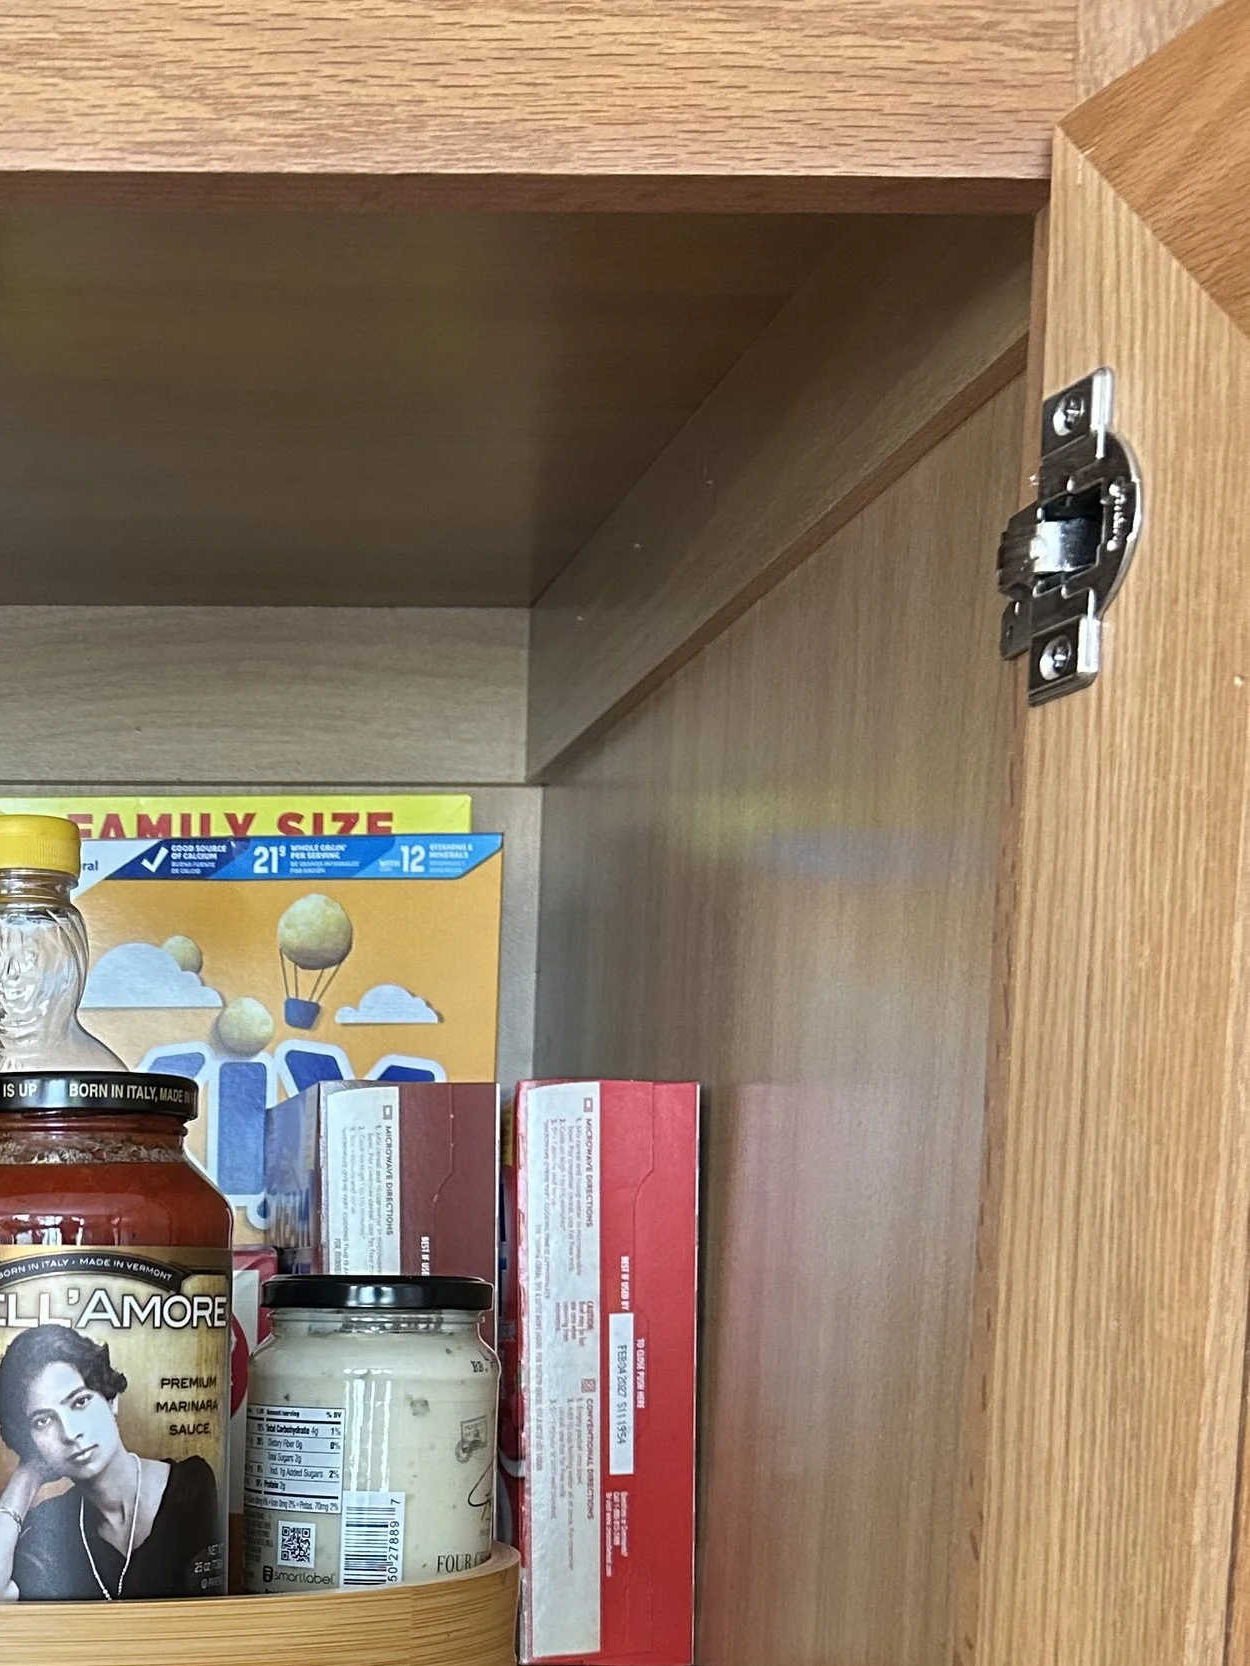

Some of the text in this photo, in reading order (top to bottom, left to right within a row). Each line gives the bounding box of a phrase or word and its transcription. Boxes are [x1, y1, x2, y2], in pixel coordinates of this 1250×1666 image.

[66, 811, 394, 839] FAMILY SIZE
[400, 845, 425, 873] 12
[2, 1082, 15, 1098] IS
[18, 1082, 38, 1097] UP
[69, 1082, 183, 1103] BORN IN ITALY, MADE
[385, 1125, 394, 1236] MICROWAVE DIRECTIONS
[585, 1118, 593, 1228] MICROWAVE DIRECTIONS
[27, 1262, 40, 1274] IN
[41, 1258, 69, 1271] ITALY
[79, 1256, 111, 1268] MADE
[113, 1259, 124, 1269] IN
[126, 1260, 173, 1282] VERMONT
[620, 1256, 630, 1274] BEST
[160, 1376, 218, 1390] PREMIUM
[155, 1400, 219, 1413] MARINARA
[169, 1424, 211, 1436] SAUCE
[586, 1398, 594, 1519] CONVENTIONAL DIRECTIONS
[387, 1520, 400, 1563] 27889
[437, 1554, 472, 1573] FOUR
